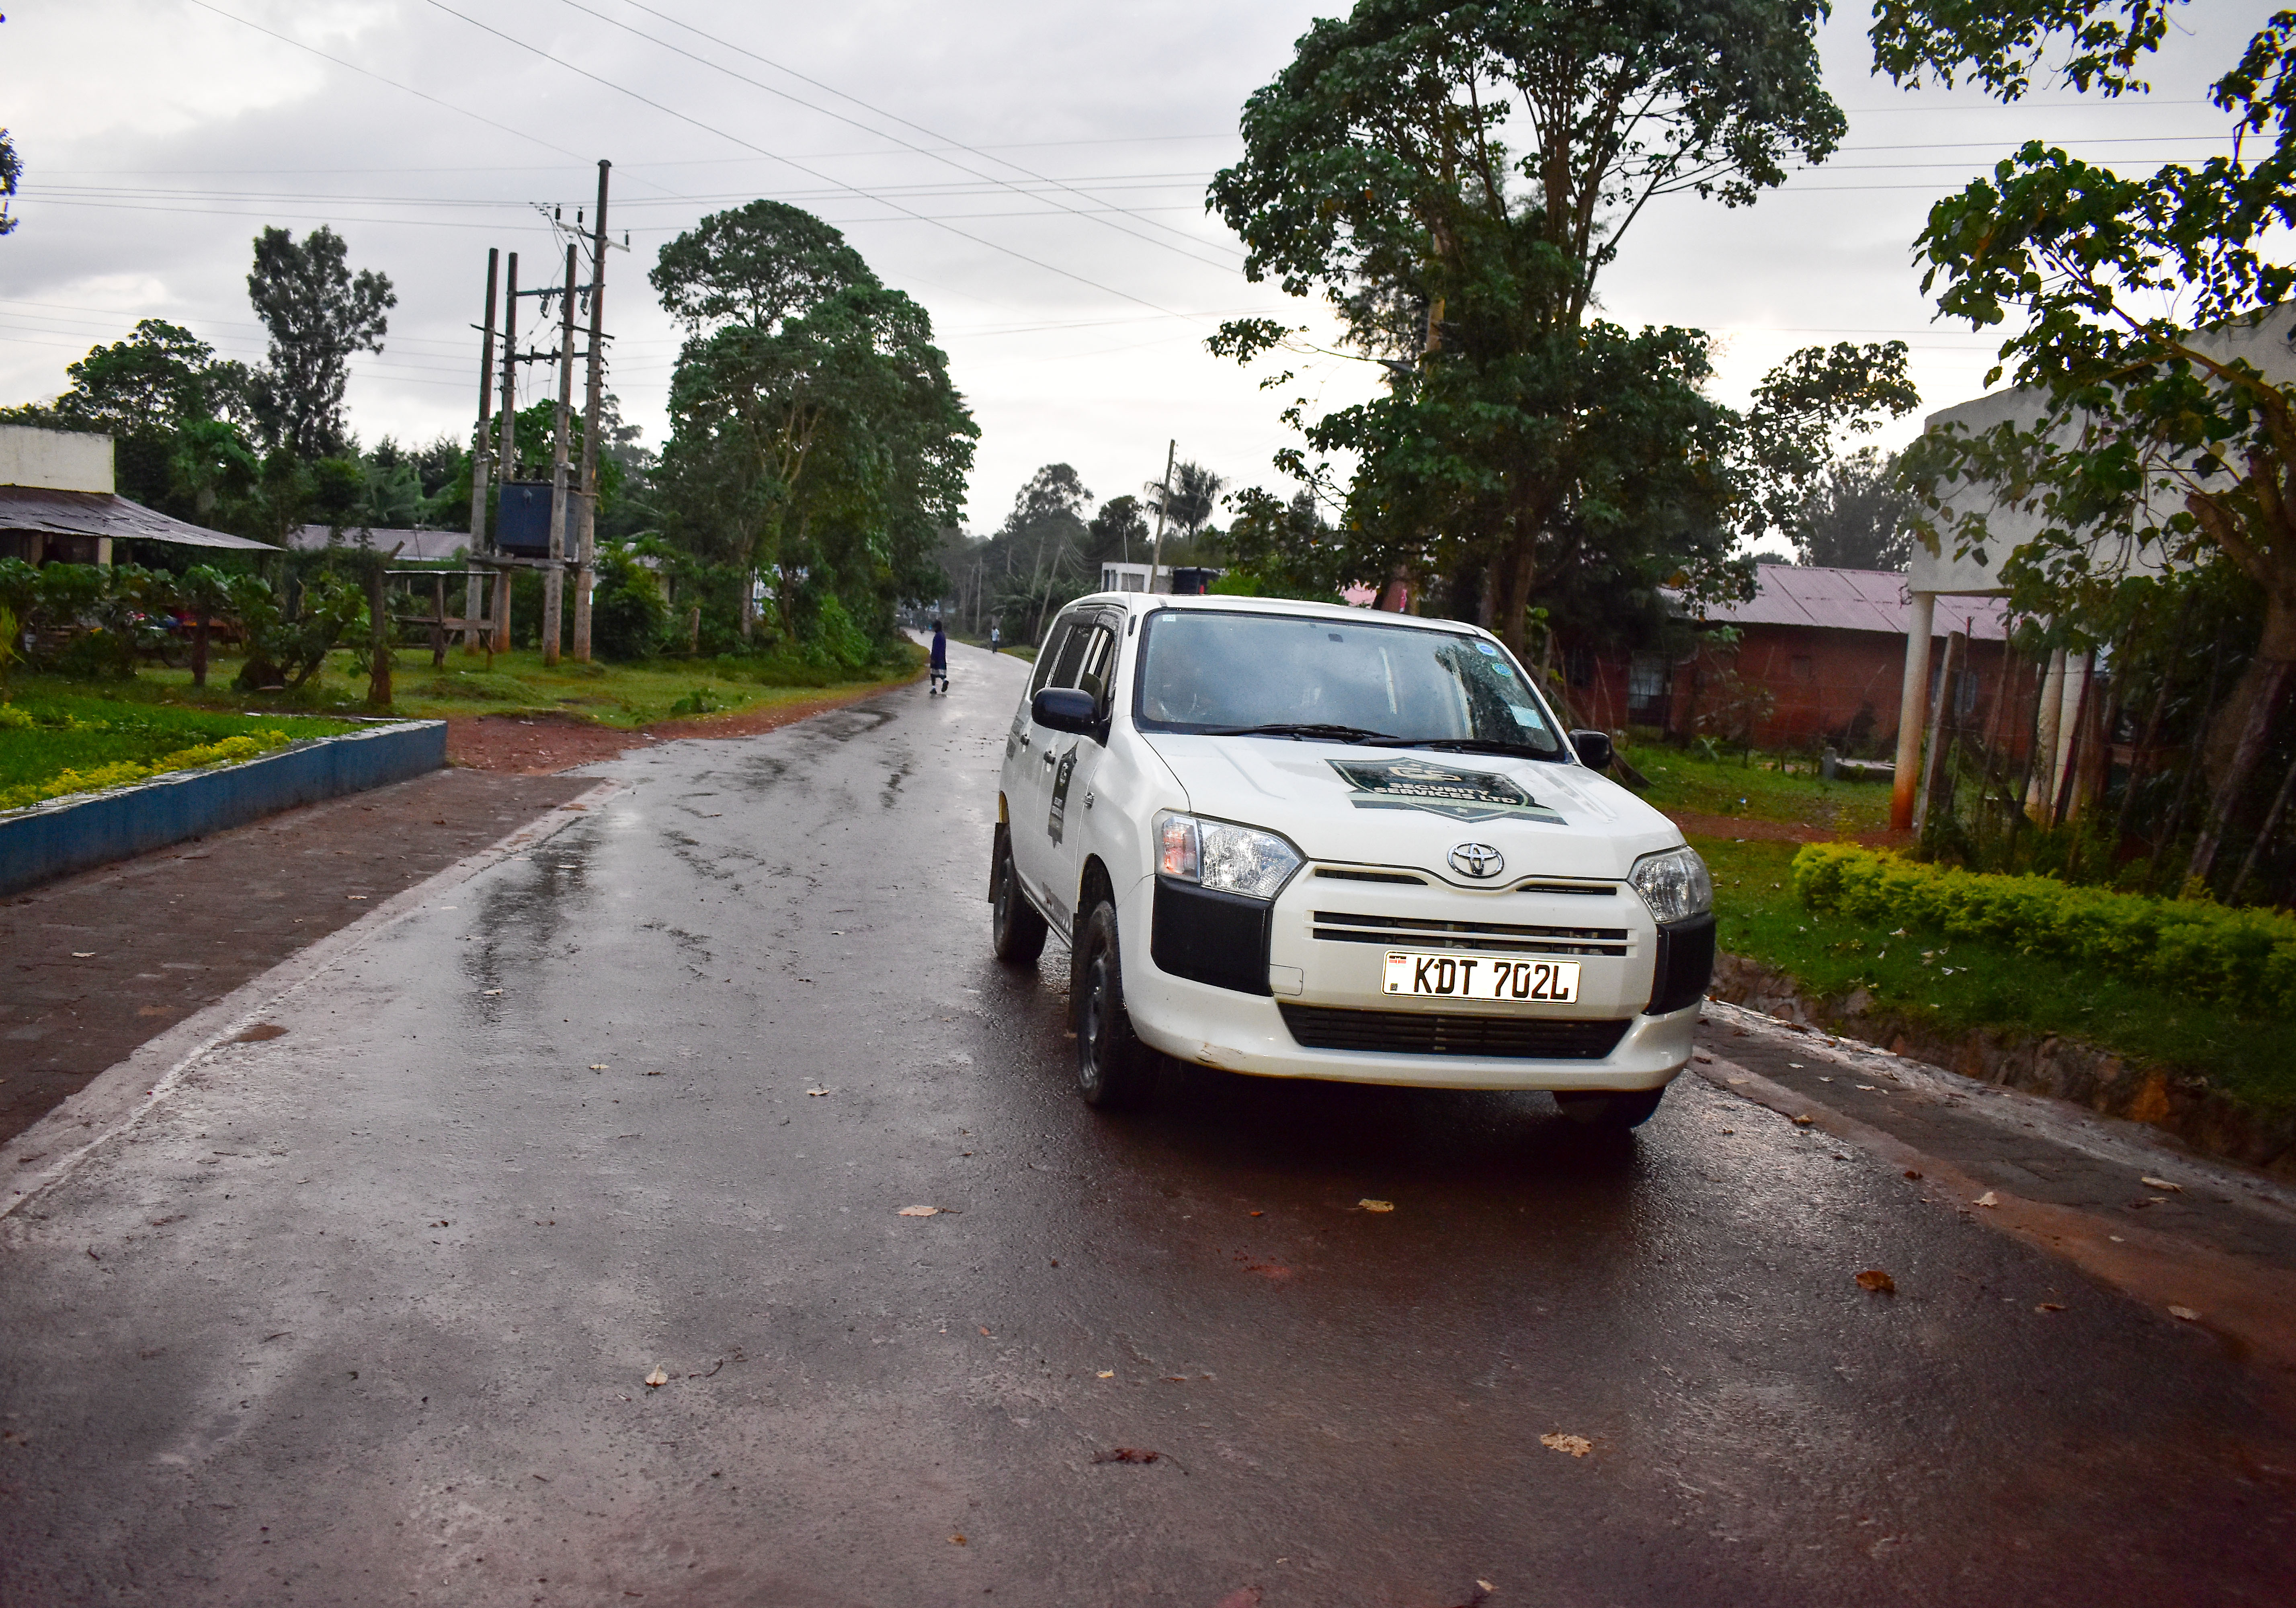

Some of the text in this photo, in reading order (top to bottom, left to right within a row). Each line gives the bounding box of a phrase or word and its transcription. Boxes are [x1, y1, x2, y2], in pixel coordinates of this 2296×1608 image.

[1374, 787, 1475, 800] SERVICES
[1479, 795, 1517, 804] LTD
[1389, 783, 1489, 796] SECURITY
[1413, 957, 1569, 1000] KDT 702L
